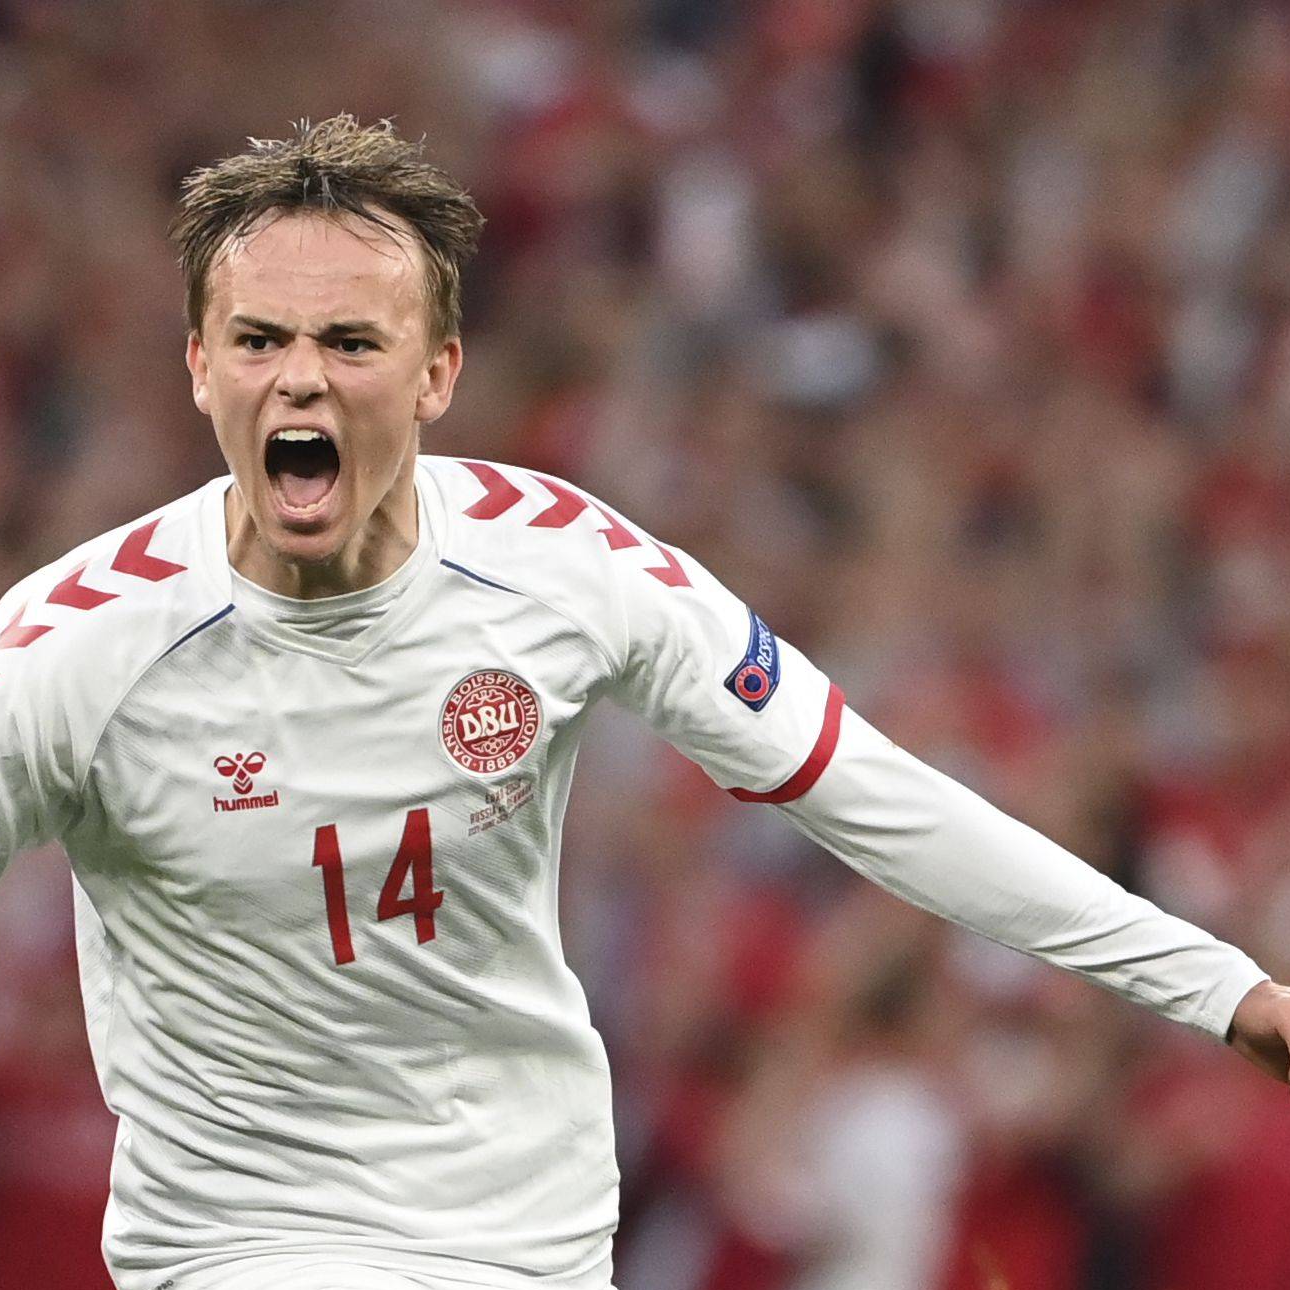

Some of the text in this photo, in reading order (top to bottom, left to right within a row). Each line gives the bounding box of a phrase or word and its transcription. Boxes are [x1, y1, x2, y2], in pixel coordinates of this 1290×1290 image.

[443, 711, 473, 767] DANSK
[517, 693, 537, 748] UNION
[459, 701, 520, 742] DBU
[478, 751, 516, 772] 1889
[213, 790, 279, 812] hummel
[312, 807, 444, 966] 14
